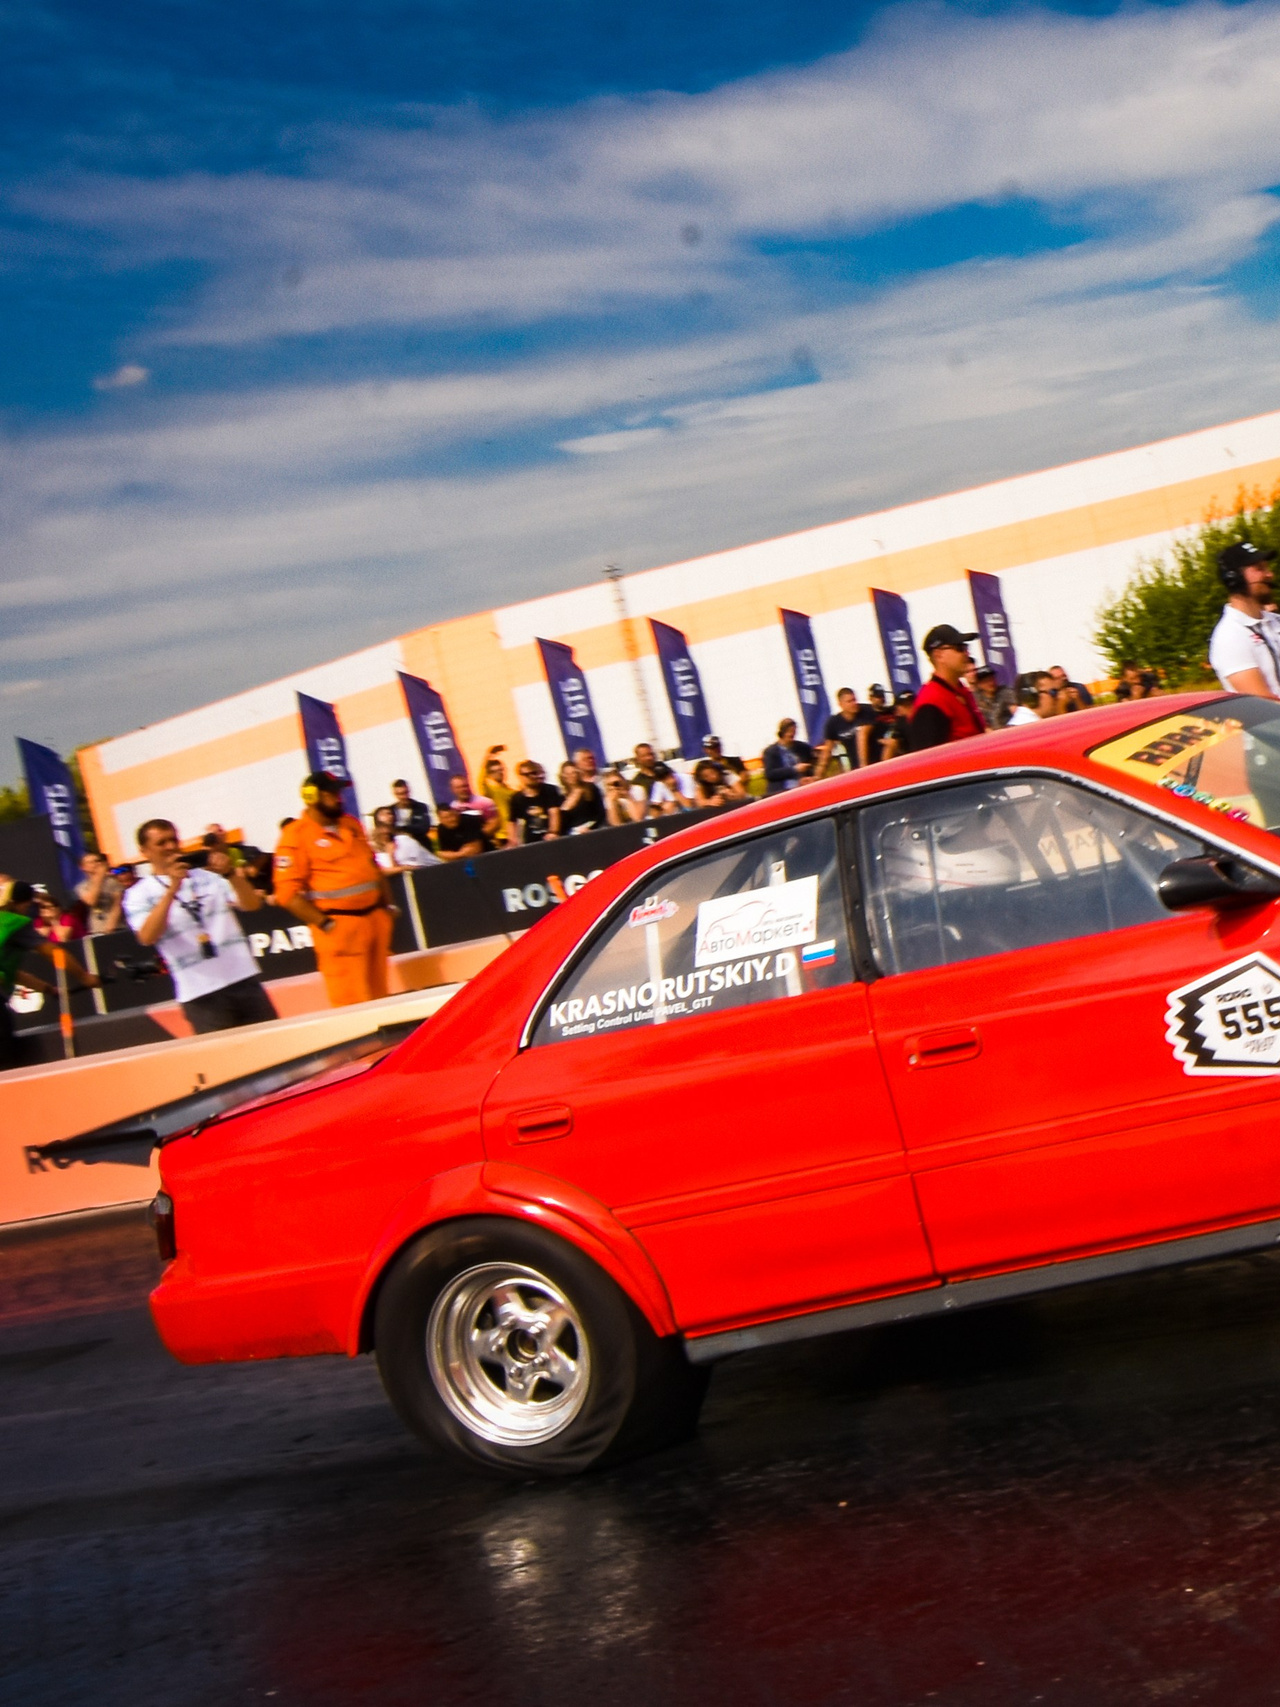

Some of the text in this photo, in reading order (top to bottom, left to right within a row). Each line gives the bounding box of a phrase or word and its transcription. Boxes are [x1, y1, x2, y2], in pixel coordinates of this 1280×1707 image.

[889, 629, 915, 666] ВТБ
[984, 612, 1010, 649] ВТБ
[671, 657, 699, 698] ВТБ
[799, 648, 822, 687] ВТБ
[560, 677, 589, 719] ВТБ
[422, 710, 455, 752] ВТБ
[549, 951, 796, 1027] KRASNORUTSKIY.D
[561, 1018, 595, 1036] Setting
[597, 1013, 632, 1029] Control
